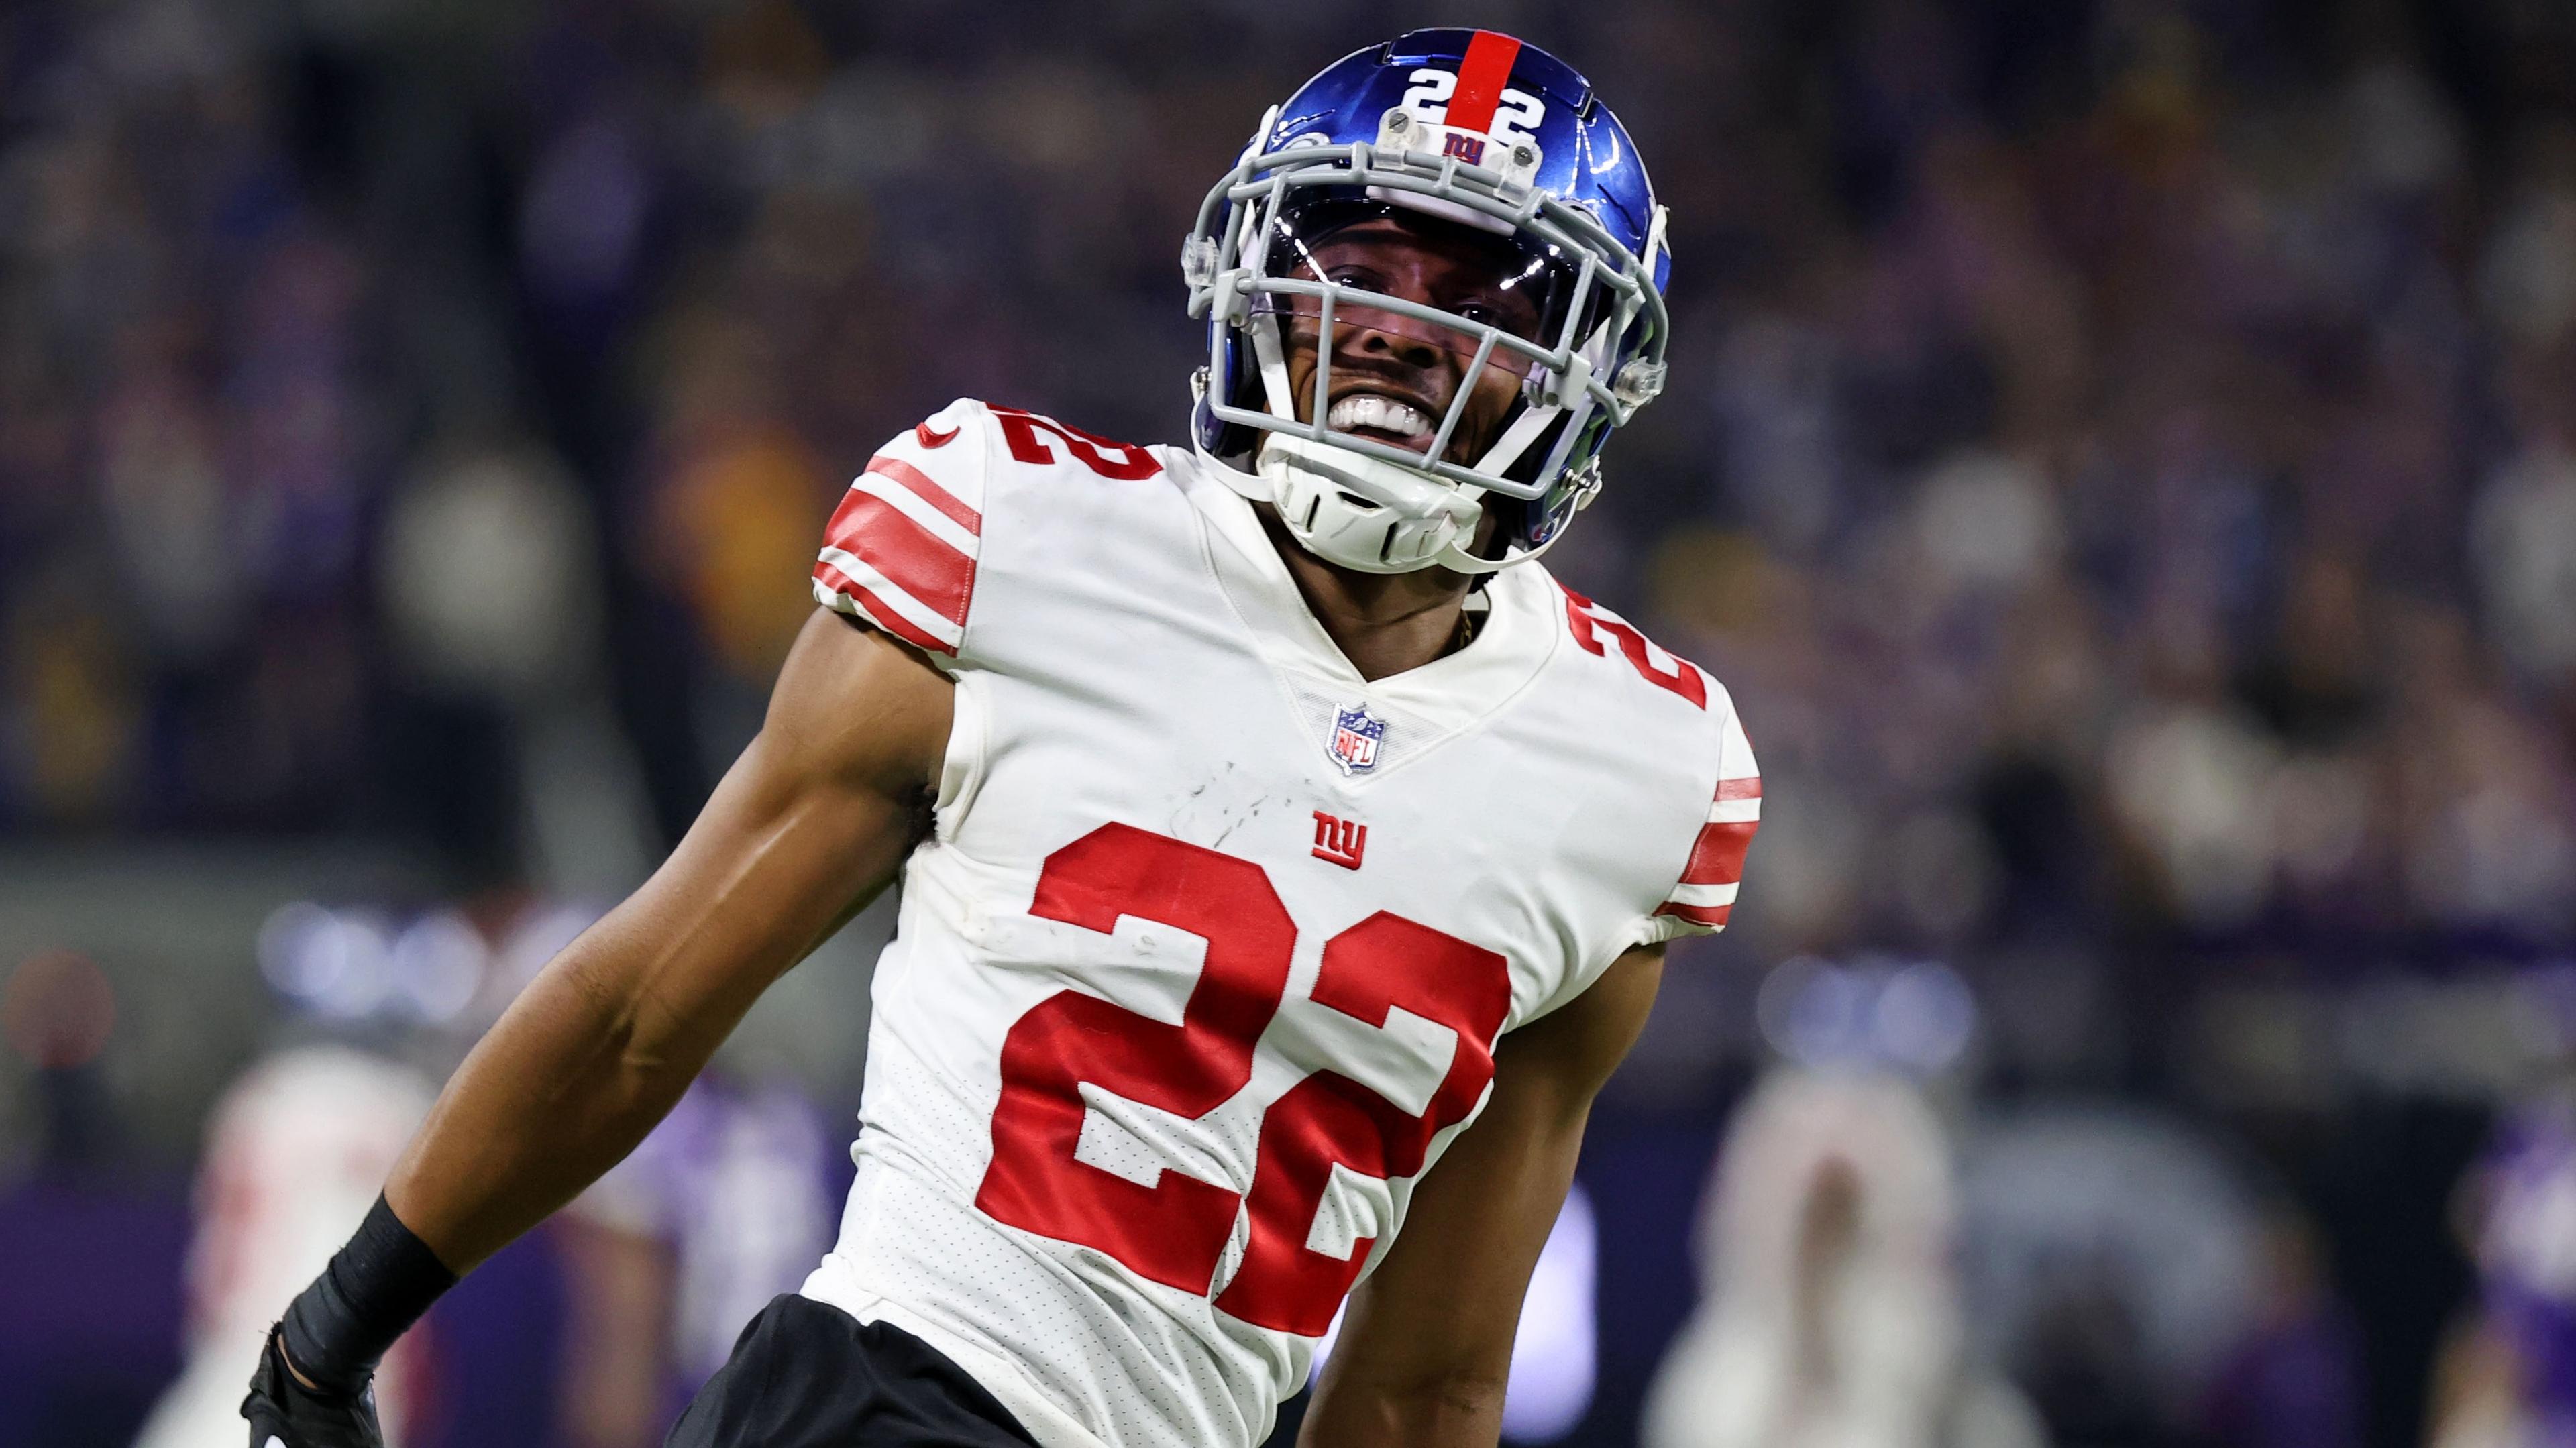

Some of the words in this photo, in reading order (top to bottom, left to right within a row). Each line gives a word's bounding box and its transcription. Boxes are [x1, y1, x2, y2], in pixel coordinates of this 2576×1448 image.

[1401, 68, 1546, 148] 22
[1336, 727, 1371, 763] NFL
[975, 821, 1512, 1337] 22
